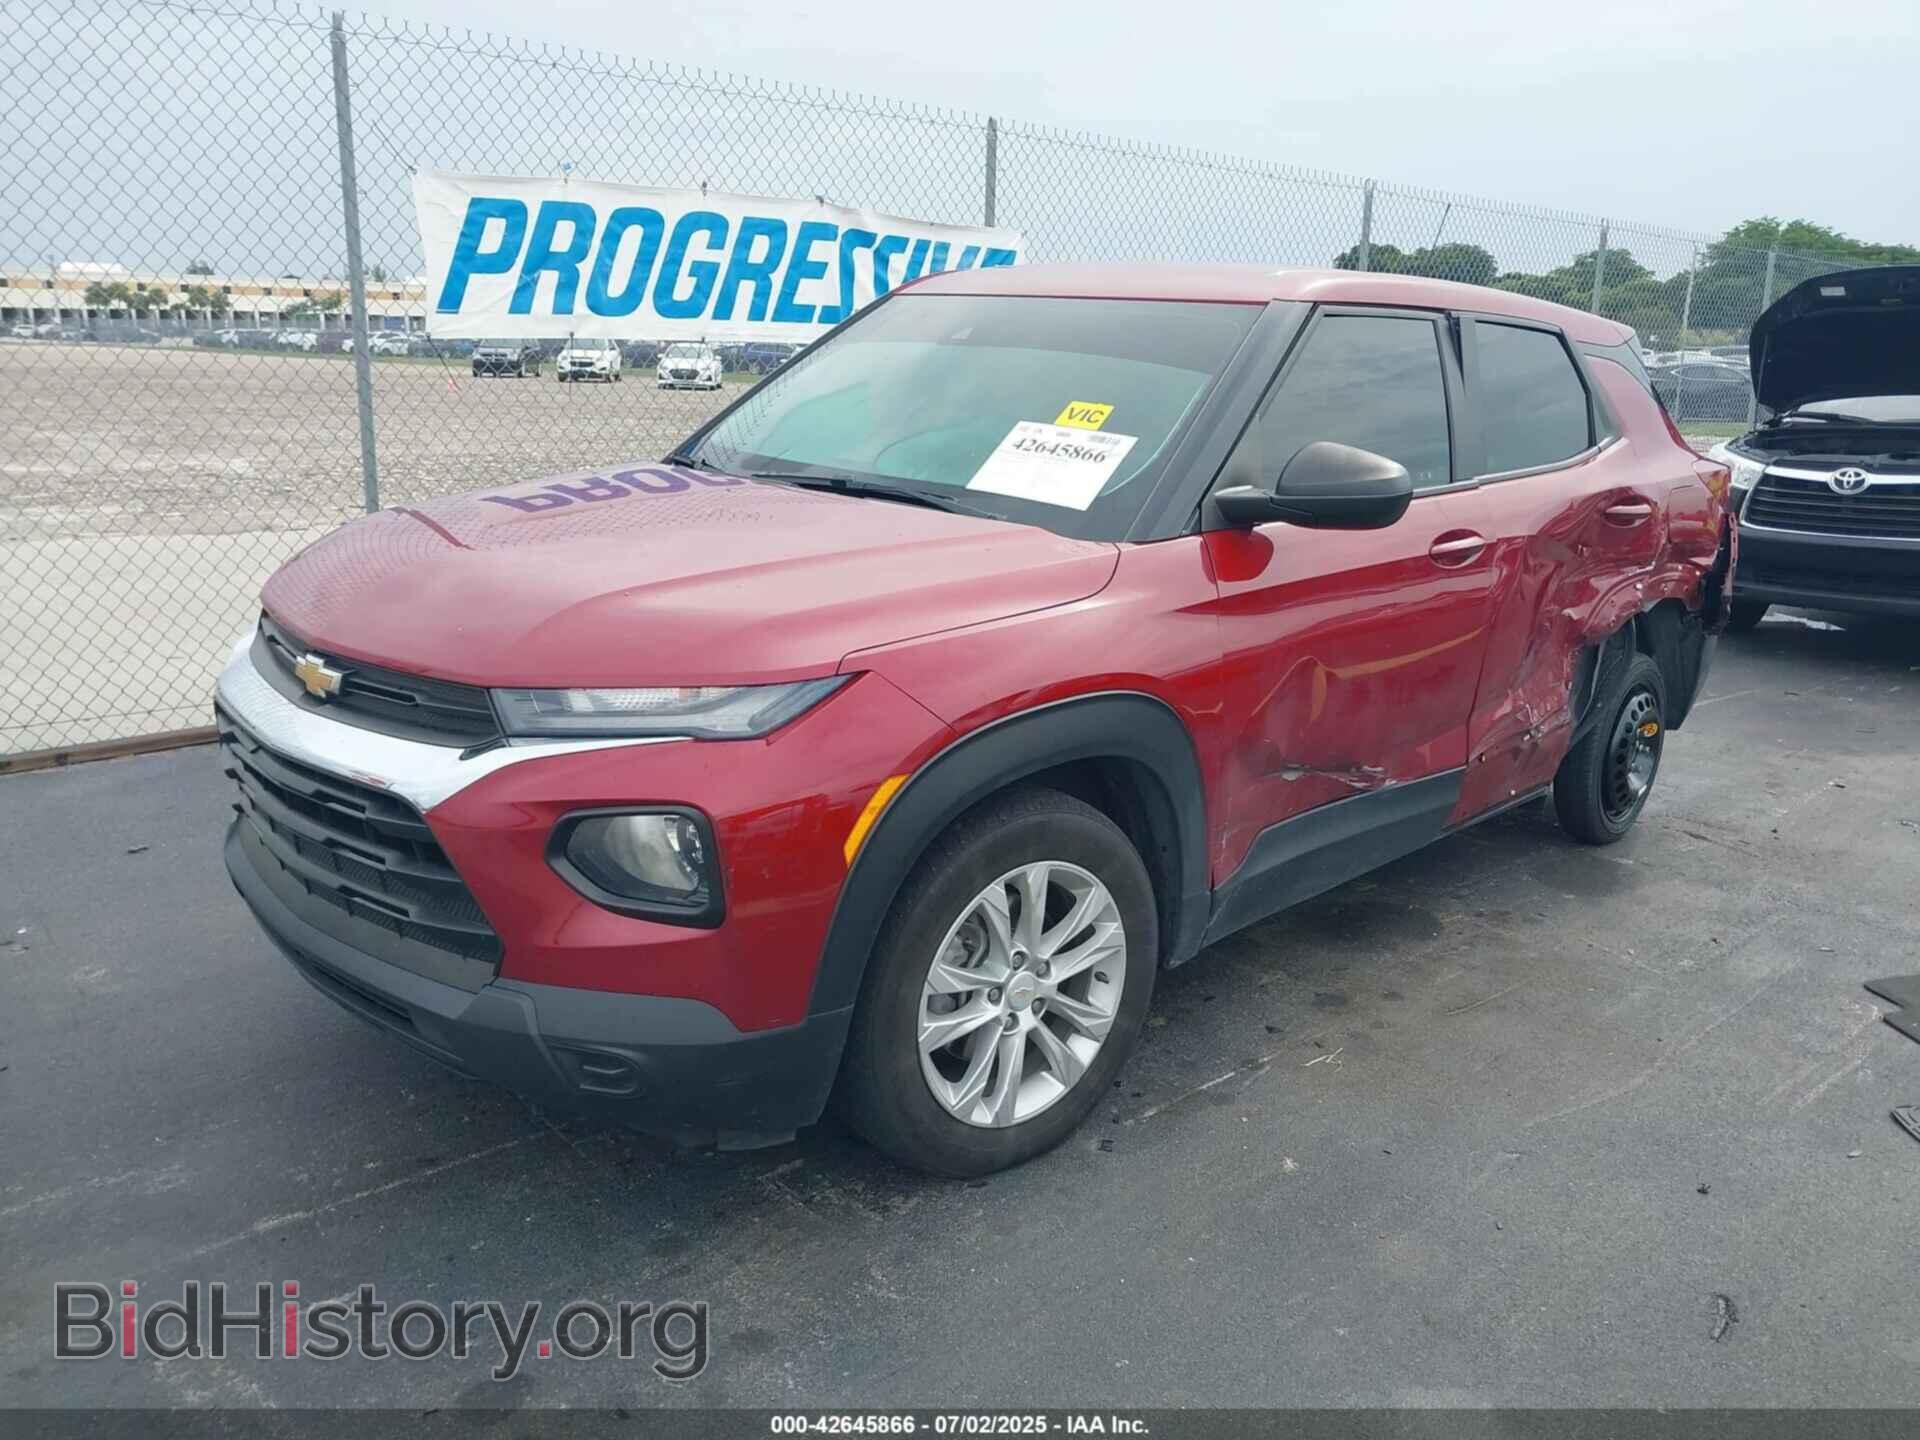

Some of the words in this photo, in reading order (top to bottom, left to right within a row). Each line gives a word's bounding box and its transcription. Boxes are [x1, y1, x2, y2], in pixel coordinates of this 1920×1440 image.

[436, 196, 1017, 325] PROGRESSI
[1067, 407, 1104, 424] VIC
[1012, 437, 1107, 463] 42645866
